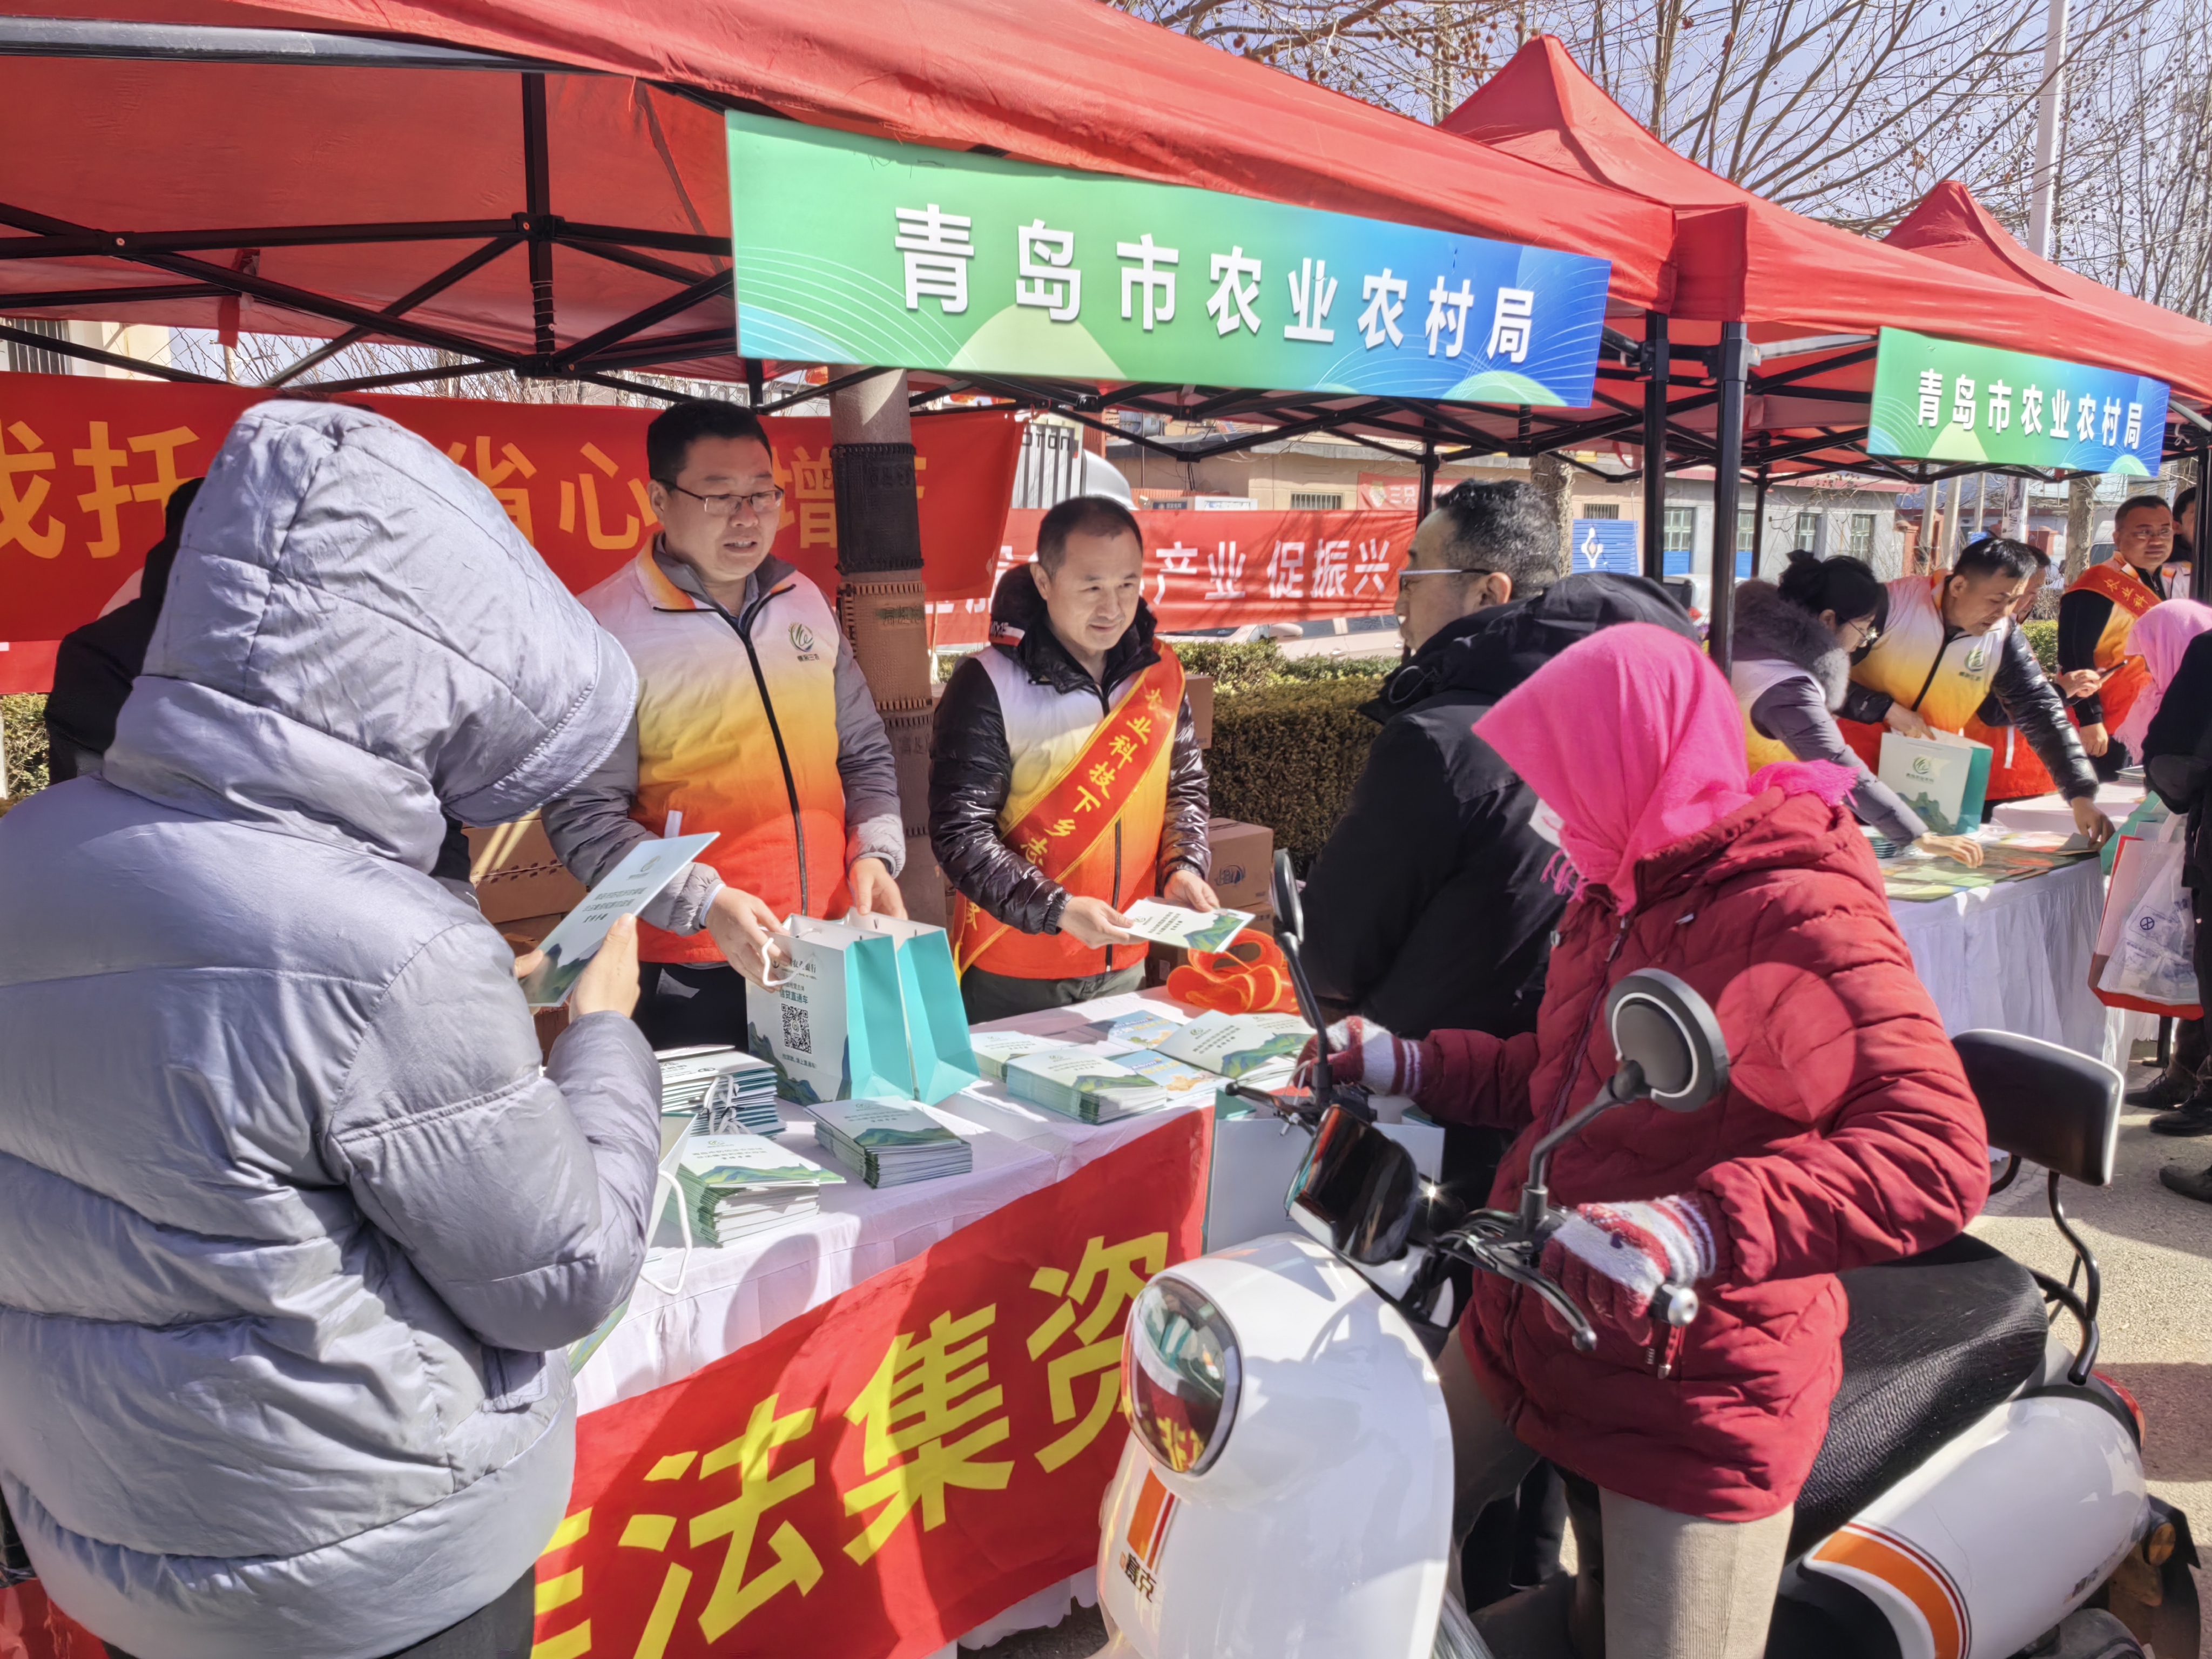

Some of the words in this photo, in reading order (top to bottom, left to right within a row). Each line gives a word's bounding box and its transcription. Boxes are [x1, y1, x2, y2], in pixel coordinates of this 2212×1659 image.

[893, 203, 1537, 365] 青岛市农业农村局
[1917, 368, 2143, 449] 青岛市农业农村局
[446, 435, 658, 550] 省心
[1153, 541, 1246, 605] 产业
[1267, 538, 1390, 598] 促振兴
[2103, 579, 2153, 609] 农业科
